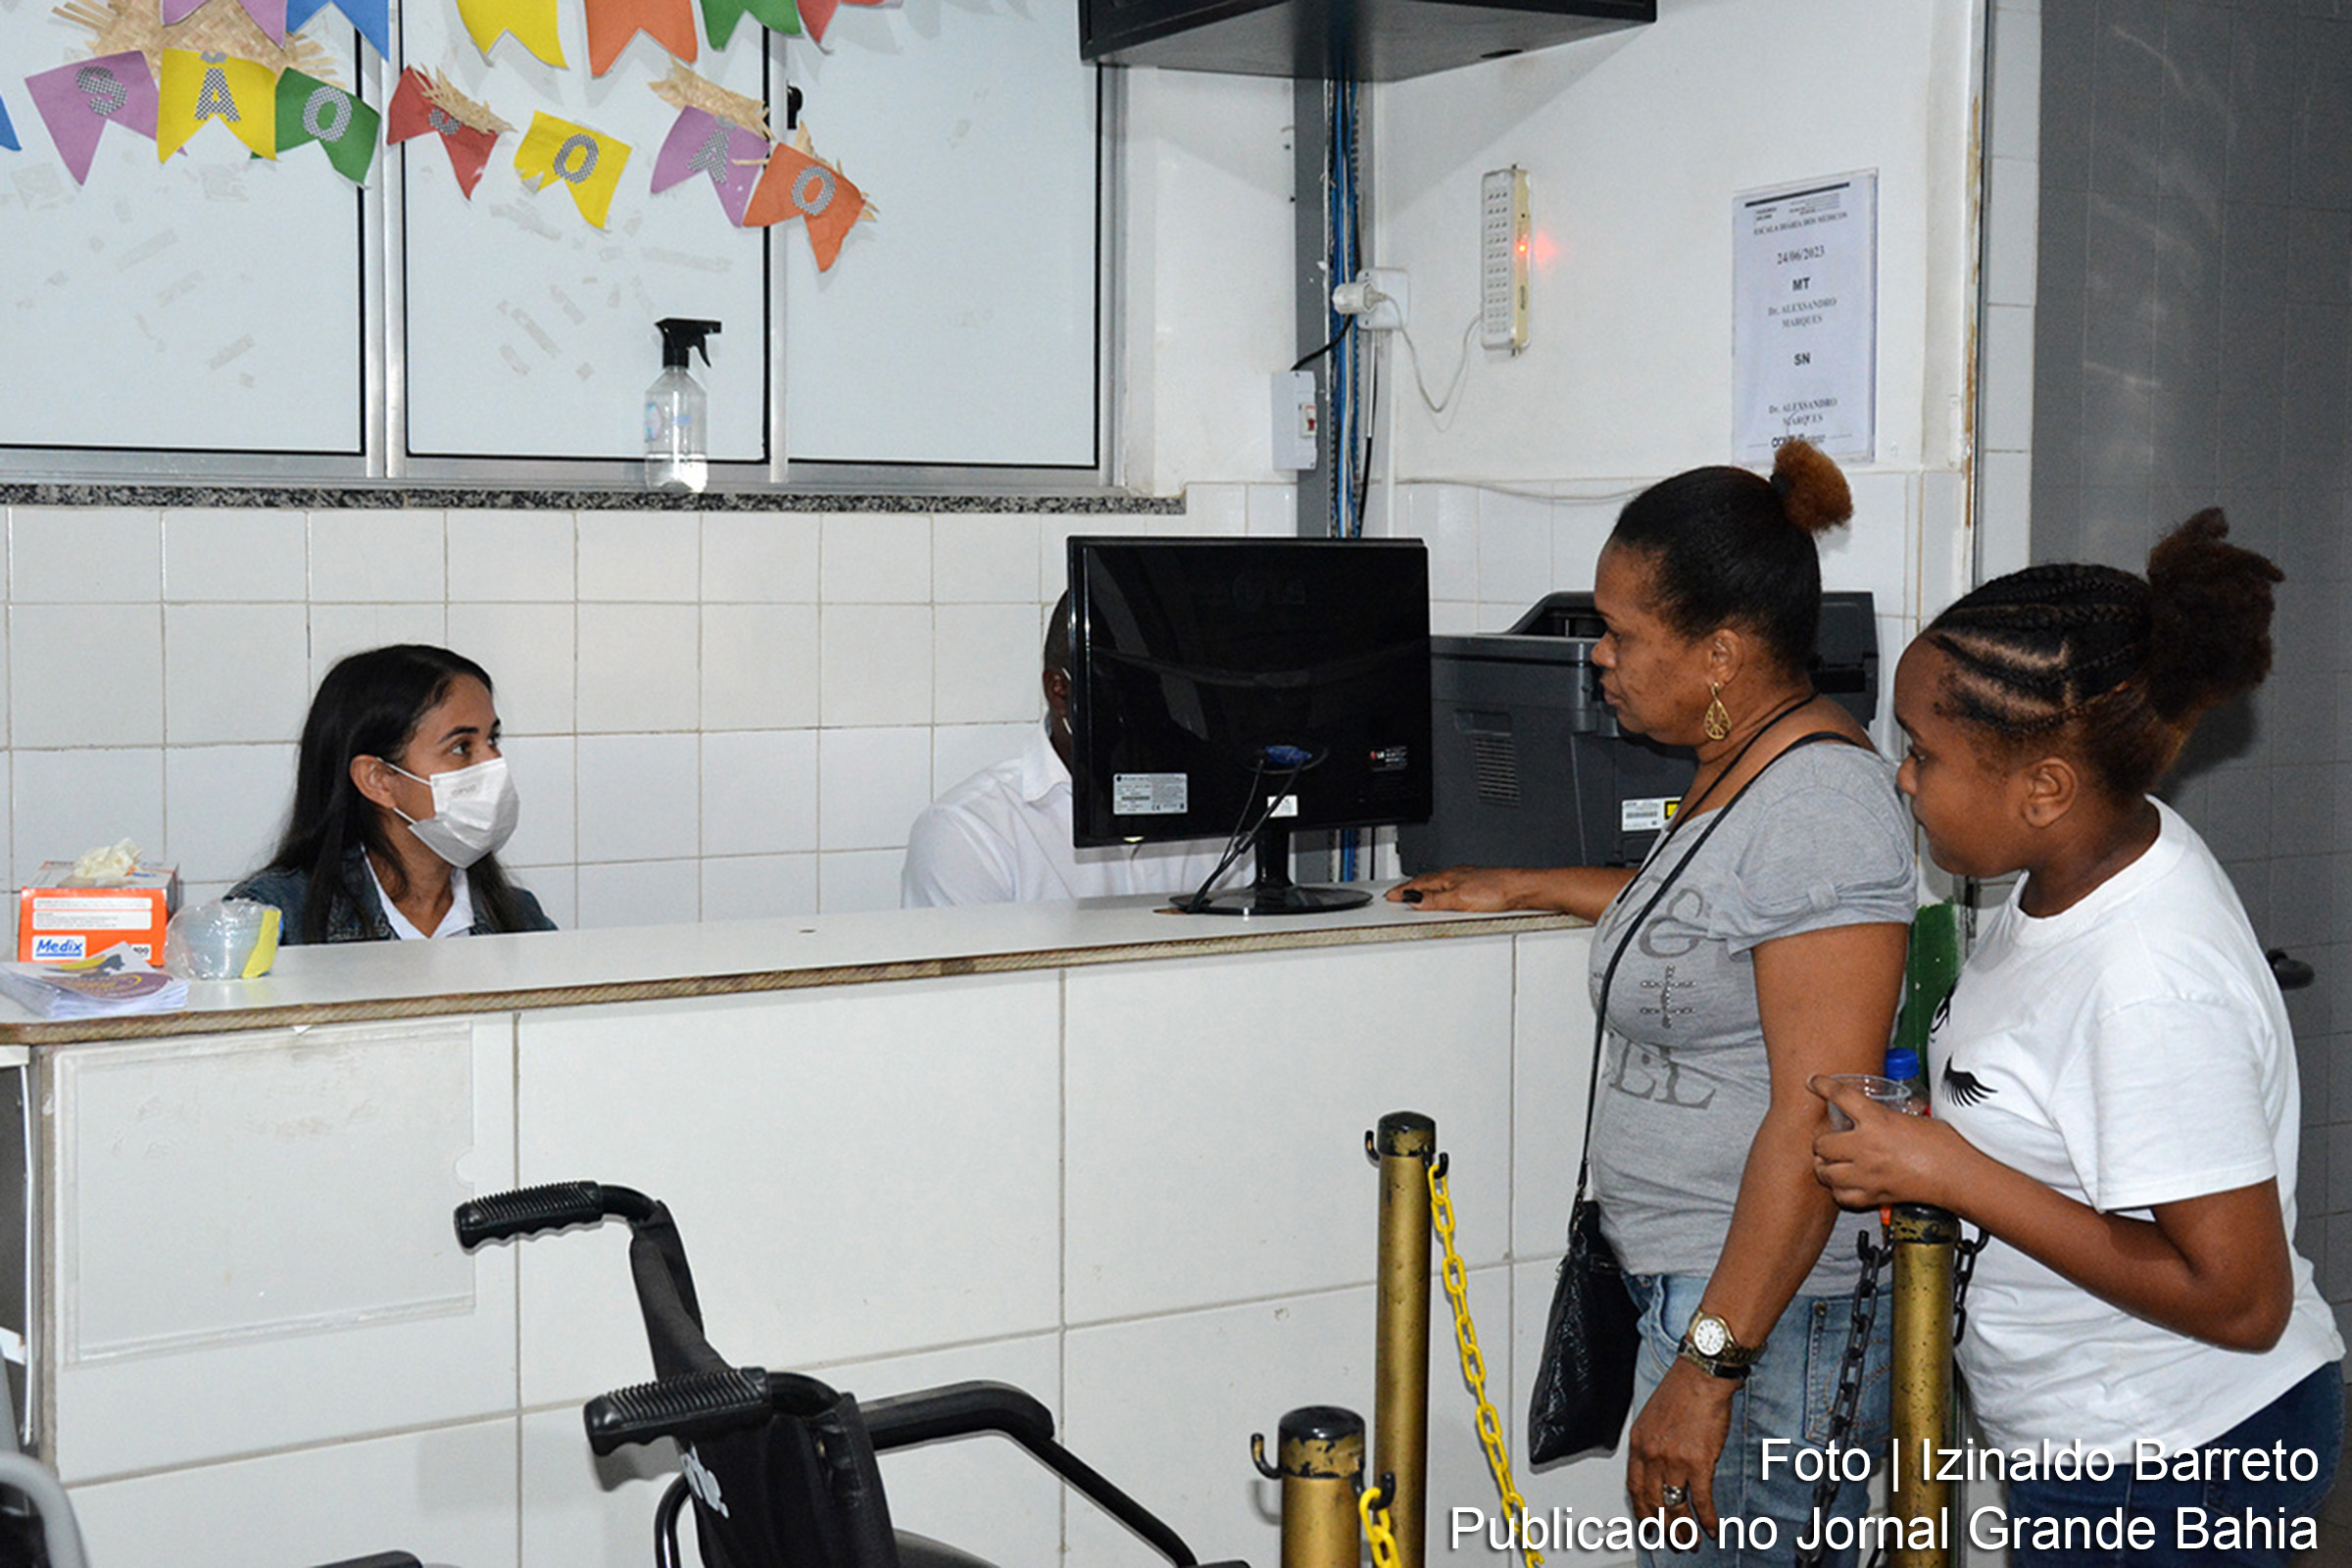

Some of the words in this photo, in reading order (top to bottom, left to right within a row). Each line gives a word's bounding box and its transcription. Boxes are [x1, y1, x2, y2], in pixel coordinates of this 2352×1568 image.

[1792, 276, 1811, 291] MT
[1782, 315, 1823, 328] MARQUES
[1793, 353, 1811, 366] SN
[1782, 397, 1838, 413] ALEXSANDRO
[1783, 413, 1824, 426] MARQUES
[35, 938, 83, 953] Medix
